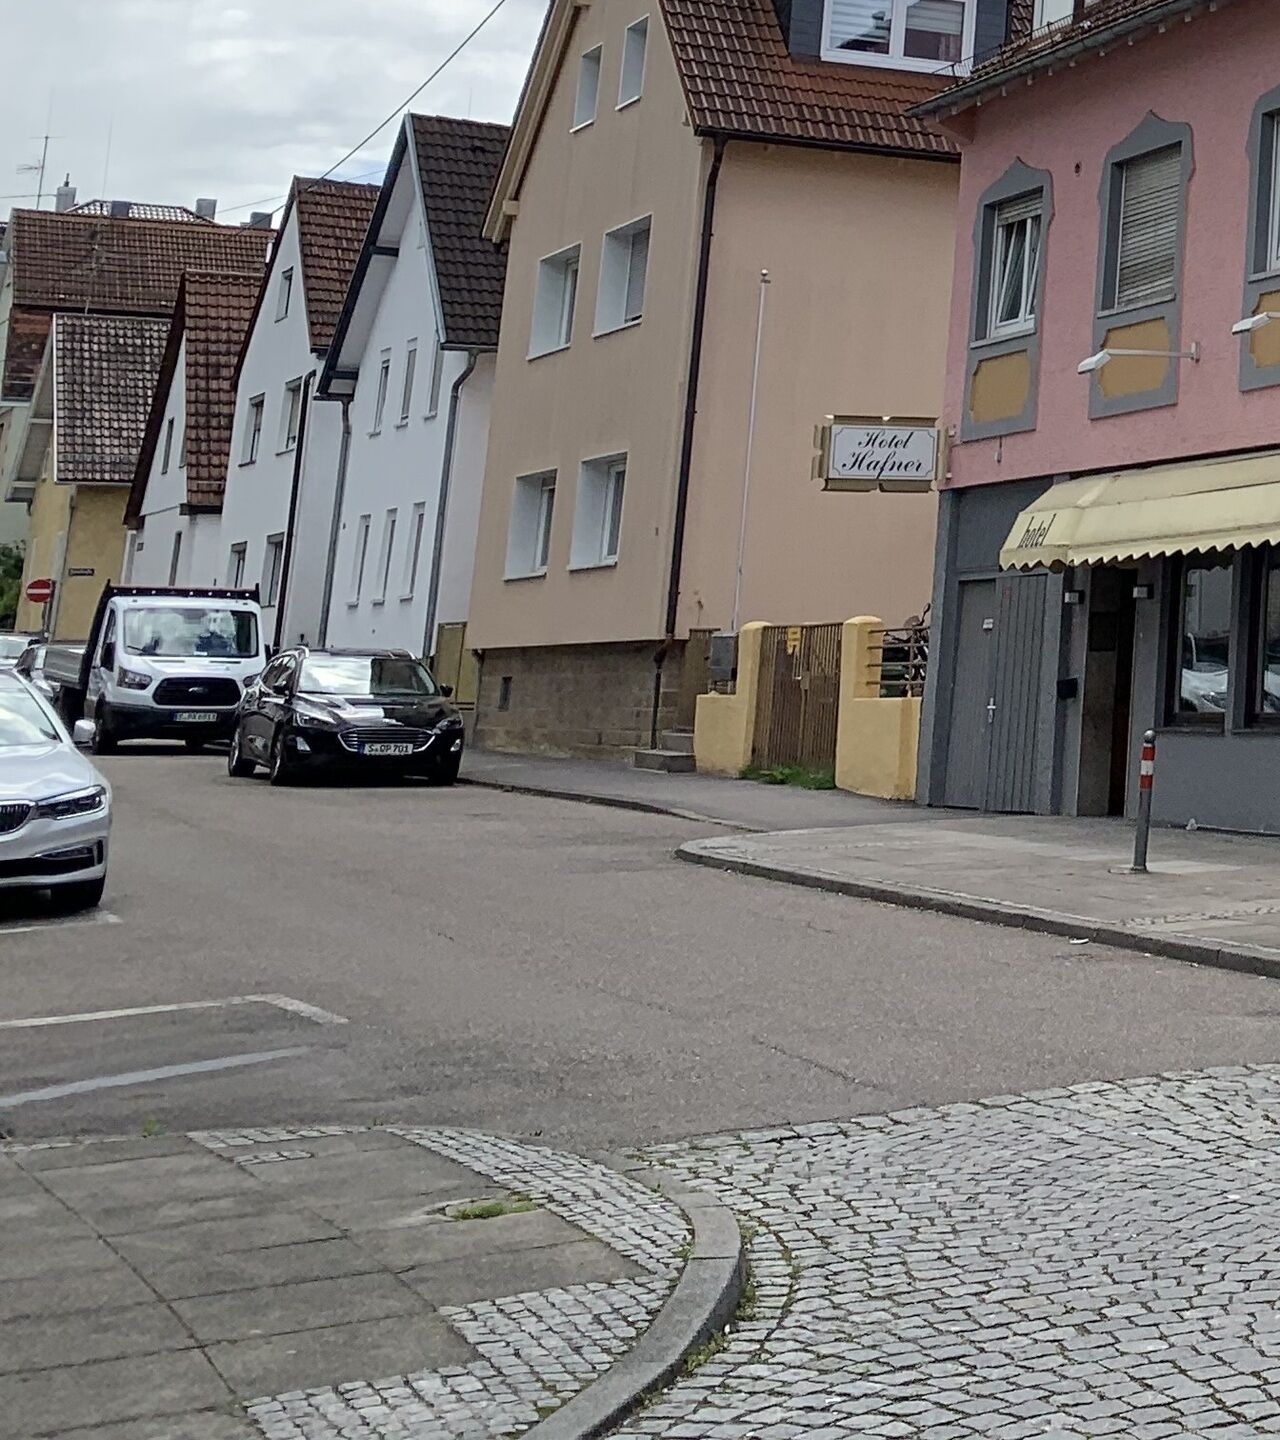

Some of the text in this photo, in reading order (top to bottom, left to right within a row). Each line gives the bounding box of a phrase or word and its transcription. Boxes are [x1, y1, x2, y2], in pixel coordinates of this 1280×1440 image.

[858, 429, 914, 449] Hotel
[842, 450, 922, 480] Hafner
[1017, 513, 1057, 549] hotel
